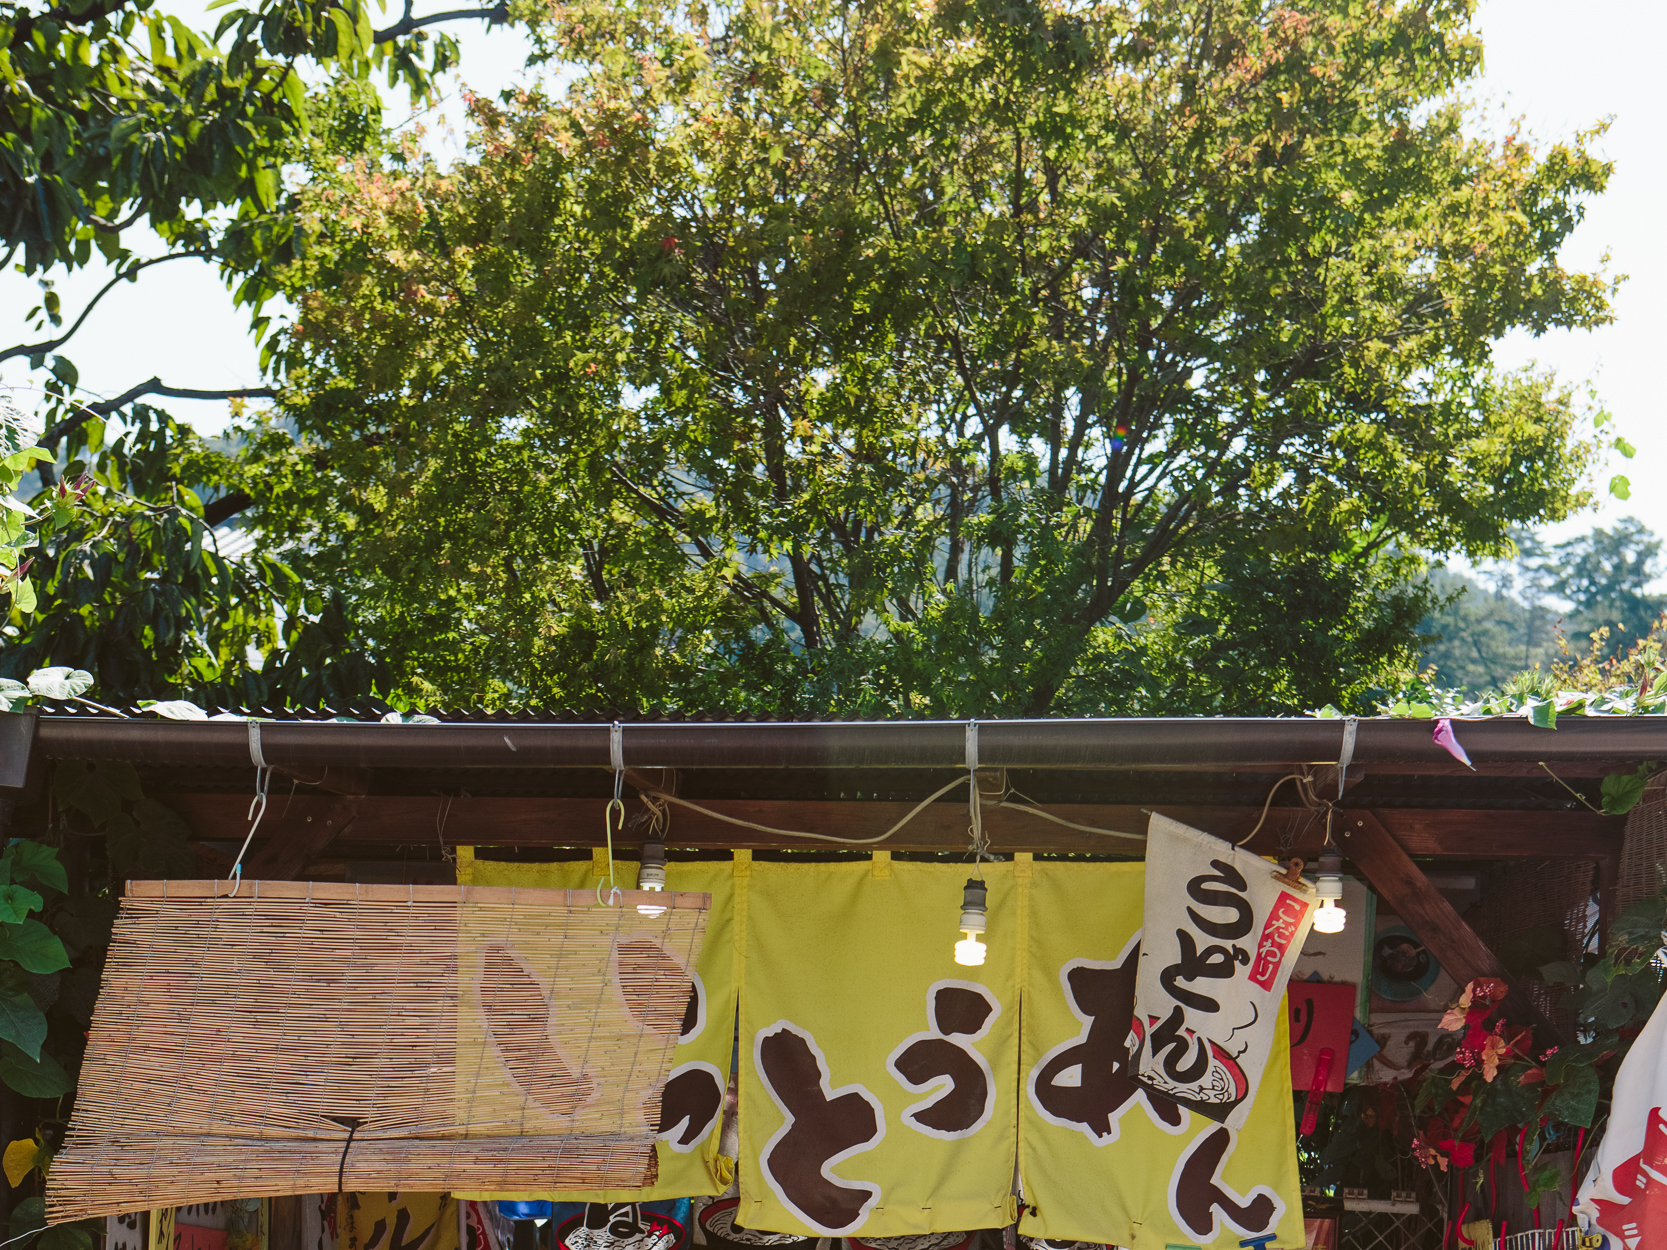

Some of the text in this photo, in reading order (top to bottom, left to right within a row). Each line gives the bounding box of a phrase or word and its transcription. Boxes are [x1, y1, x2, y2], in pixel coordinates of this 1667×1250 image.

[1152, 859, 1254, 1084] うどん
[1256, 898, 1301, 982] こだわり
